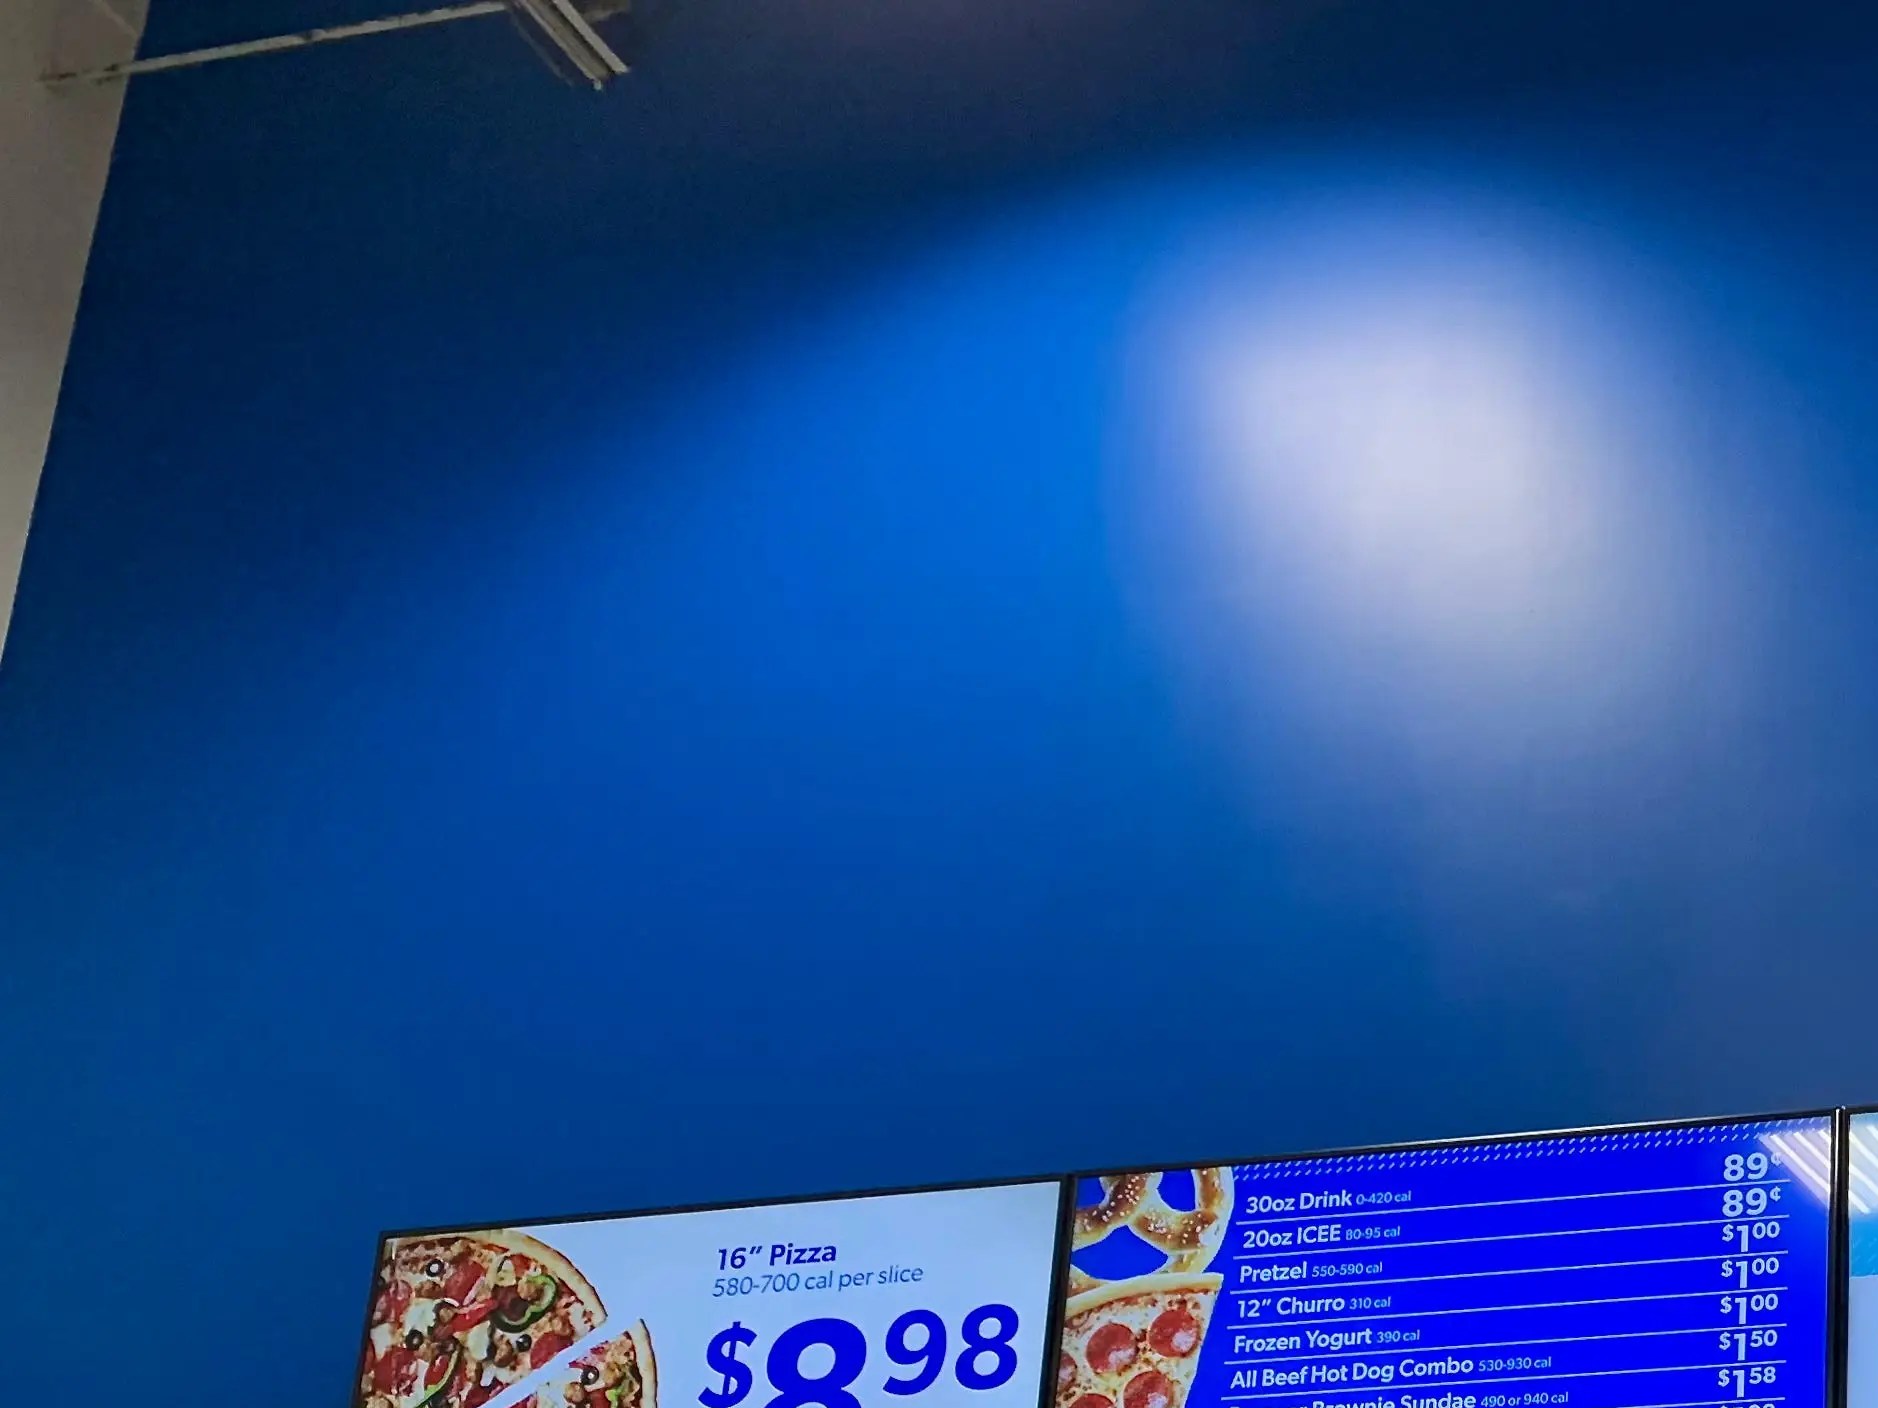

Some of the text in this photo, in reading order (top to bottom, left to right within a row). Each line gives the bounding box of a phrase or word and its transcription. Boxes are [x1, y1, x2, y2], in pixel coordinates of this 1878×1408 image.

[1246, 1189, 1411, 1214] 30oz Drink 0-420 cal
[1243, 1224, 1400, 1248] 20oz ICEE 80-95 cal
[769, 1240, 837, 1267] Pizza
[711, 1262, 924, 1298] 580-700 cal per slice
[1239, 1261, 1383, 1282] Pretzel 550-590 cal
[1276, 1296, 1345, 1316] Churro
[1349, 1297, 1372, 1310] 310
[1374, 1296, 1391, 1309] cal
[1234, 1328, 1420, 1353] Frozen Yogurt 390 cal
[1230, 1356, 1552, 1389] All Beef Hot Dog Combo 530-930 cal
[1480, 1394, 1505, 1407] 490
[1507, 1395, 1521, 1406] or
[1523, 1392, 1549, 1405] 940
[1551, 1391, 1569, 1403] cal
